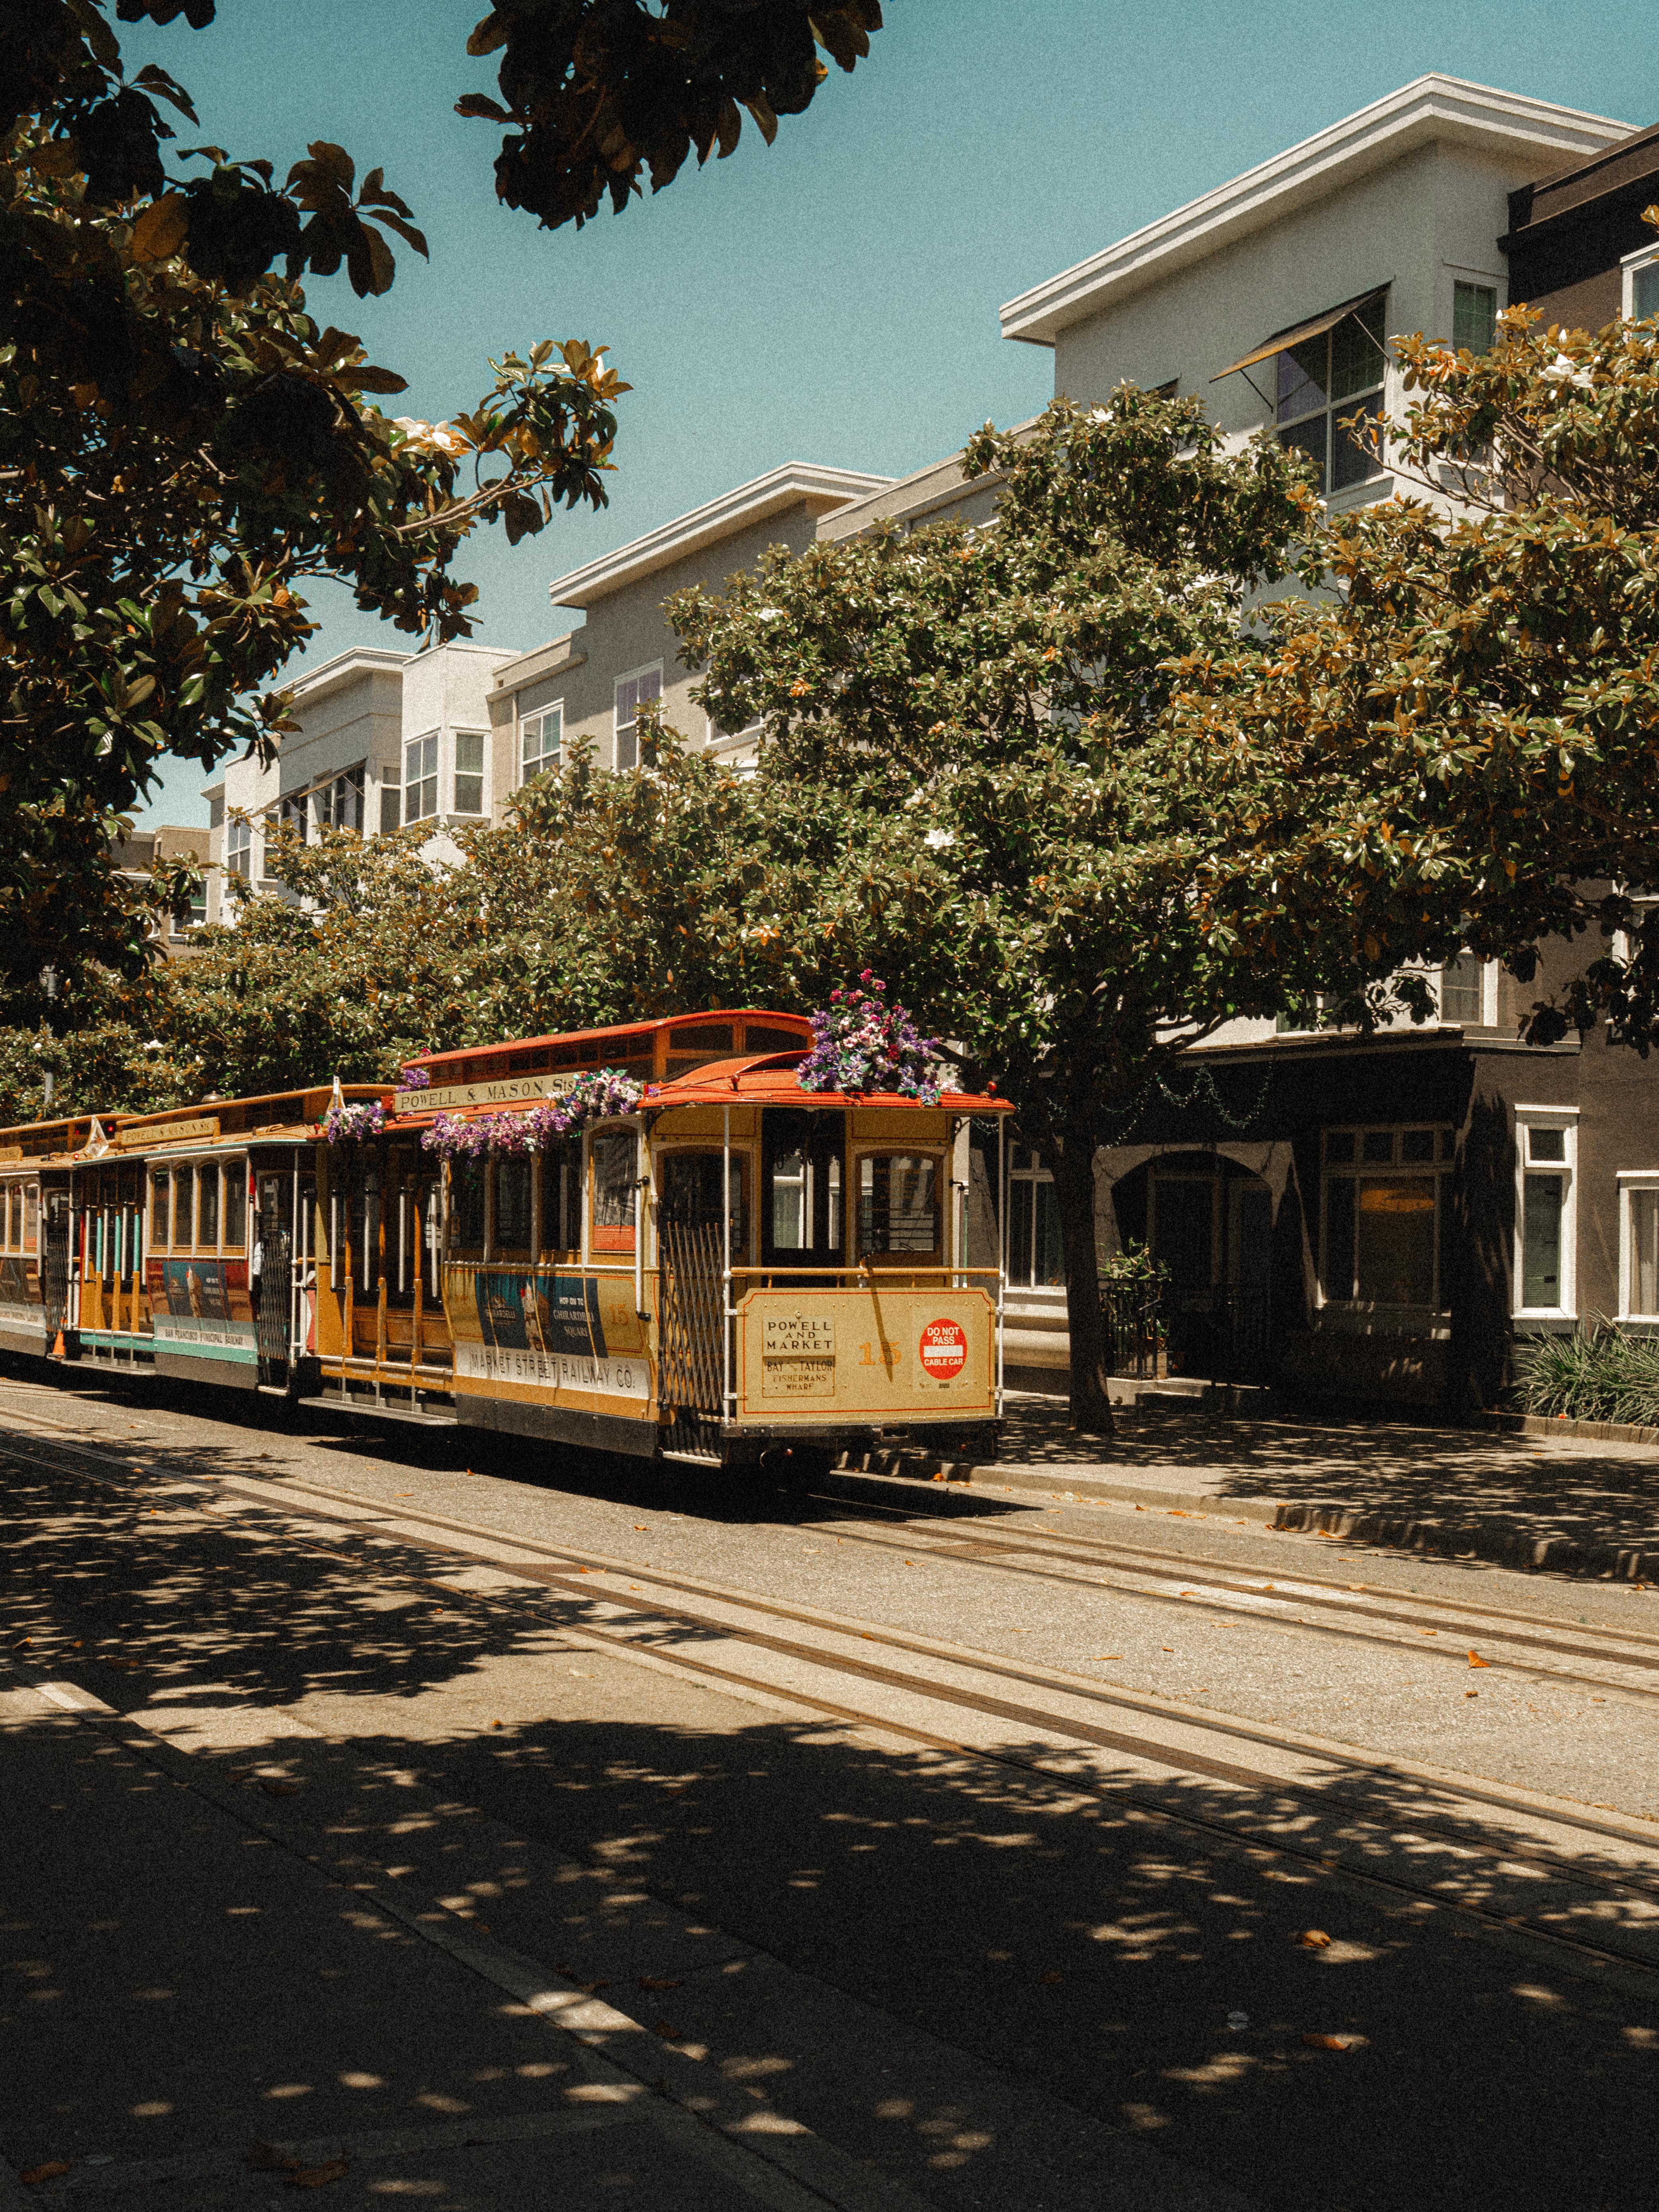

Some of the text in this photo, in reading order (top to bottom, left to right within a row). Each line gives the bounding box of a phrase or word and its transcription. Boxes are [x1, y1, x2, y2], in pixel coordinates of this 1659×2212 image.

[401, 1091, 456, 1109] POWELL
[467, 1088, 477, 1101] &
[487, 1081, 543, 1099] MASON
[125, 1128, 156, 1142] POWELL
[168, 1121, 197, 1136] MASON
[559, 1297, 584, 1306] HOP ON TO
[608, 1303, 629, 1326] 15
[564, 1325, 589, 1338] SQUARE
[768, 1321, 831, 1331] POWELL
[927, 1327, 960, 1336] DO NOT
[767, 1340, 832, 1349] MARKET
[932, 1336, 955, 1345] PASS
[859, 1341, 902, 1365] 15
[471, 1353, 635, 1389] MARKET STREET RAILWAY CO.
[767, 1361, 783, 1372] BAY
[798, 1361, 832, 1371] TAYLOR
